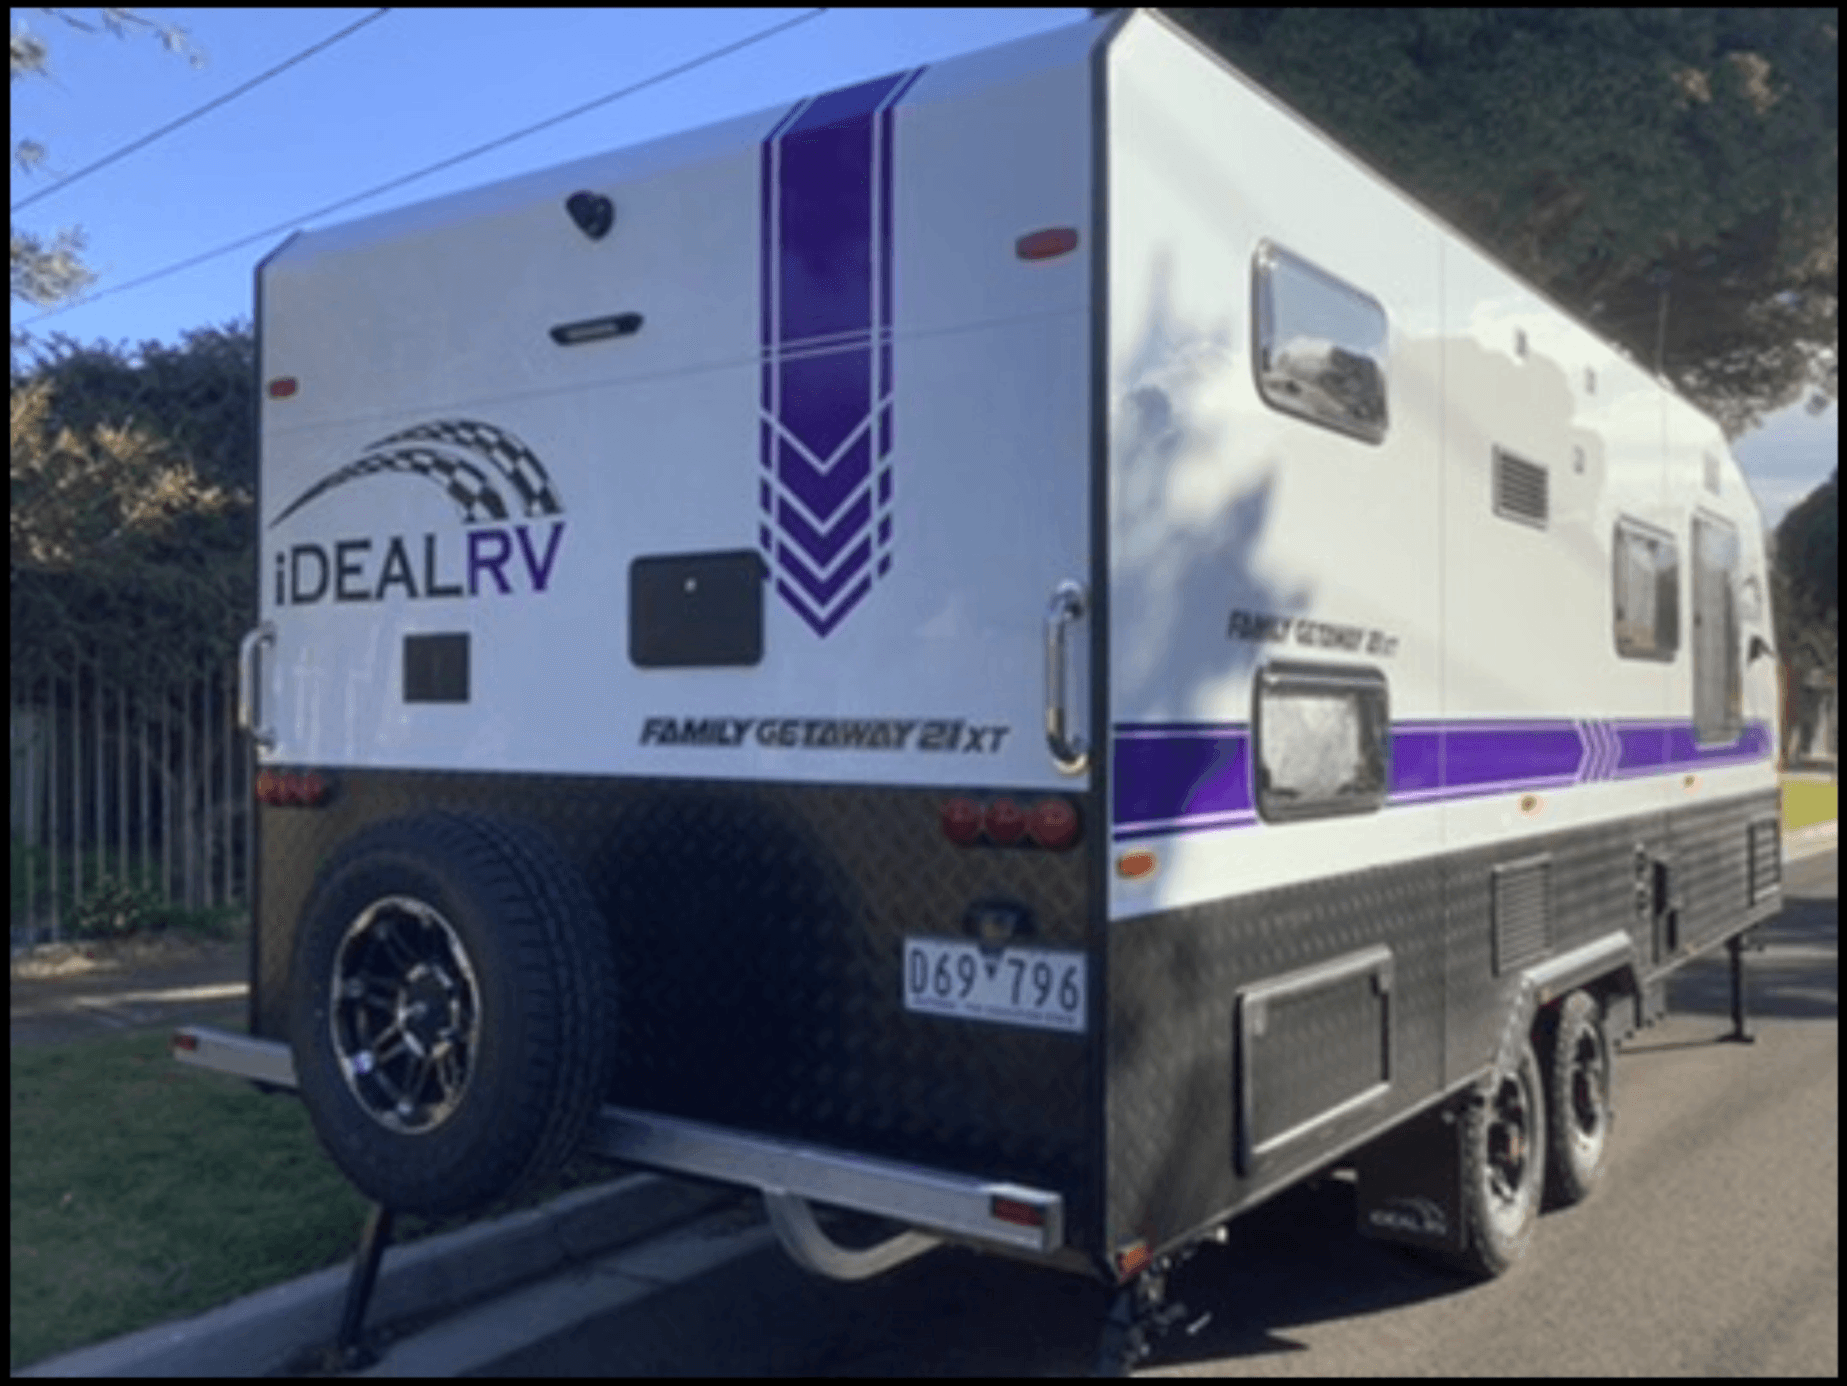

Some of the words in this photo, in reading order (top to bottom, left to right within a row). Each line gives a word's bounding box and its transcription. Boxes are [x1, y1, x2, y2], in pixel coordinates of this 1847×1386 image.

[639, 717, 751, 748] FAMILY
[754, 718, 914, 750] GETAWAY
[1007, 957, 1080, 1013] 796
